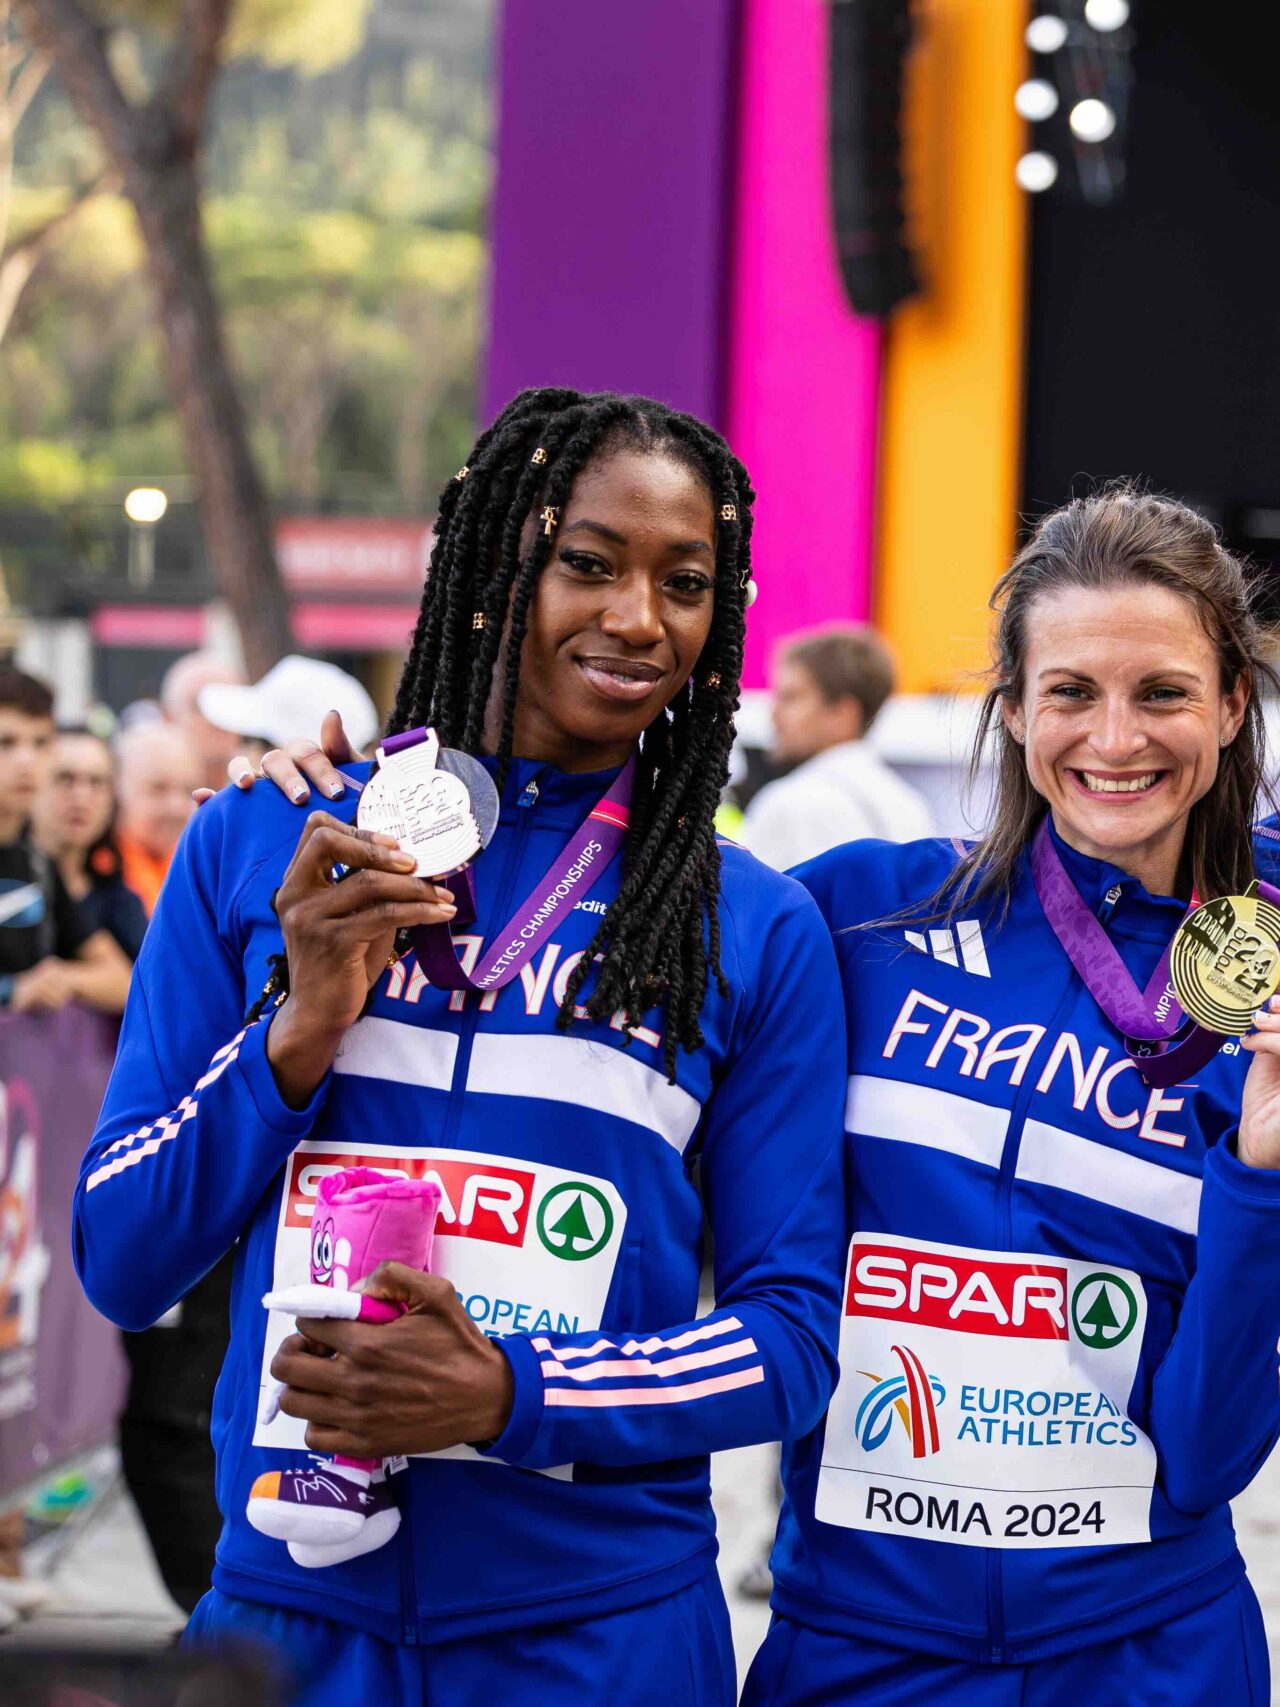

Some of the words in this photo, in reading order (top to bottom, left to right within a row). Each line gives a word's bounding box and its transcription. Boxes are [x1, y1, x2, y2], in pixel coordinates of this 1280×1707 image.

[520, 839, 603, 939] CHAMPIONSHIPS
[1213, 926, 1248, 974] roma
[882, 988, 1199, 1148] FRANCE
[853, 1254, 1066, 1329] SPAR
[957, 1416, 1138, 1447] ATHLETICS
[865, 1486, 993, 1536] ROMA
[1004, 1500, 1106, 1537] 2024
